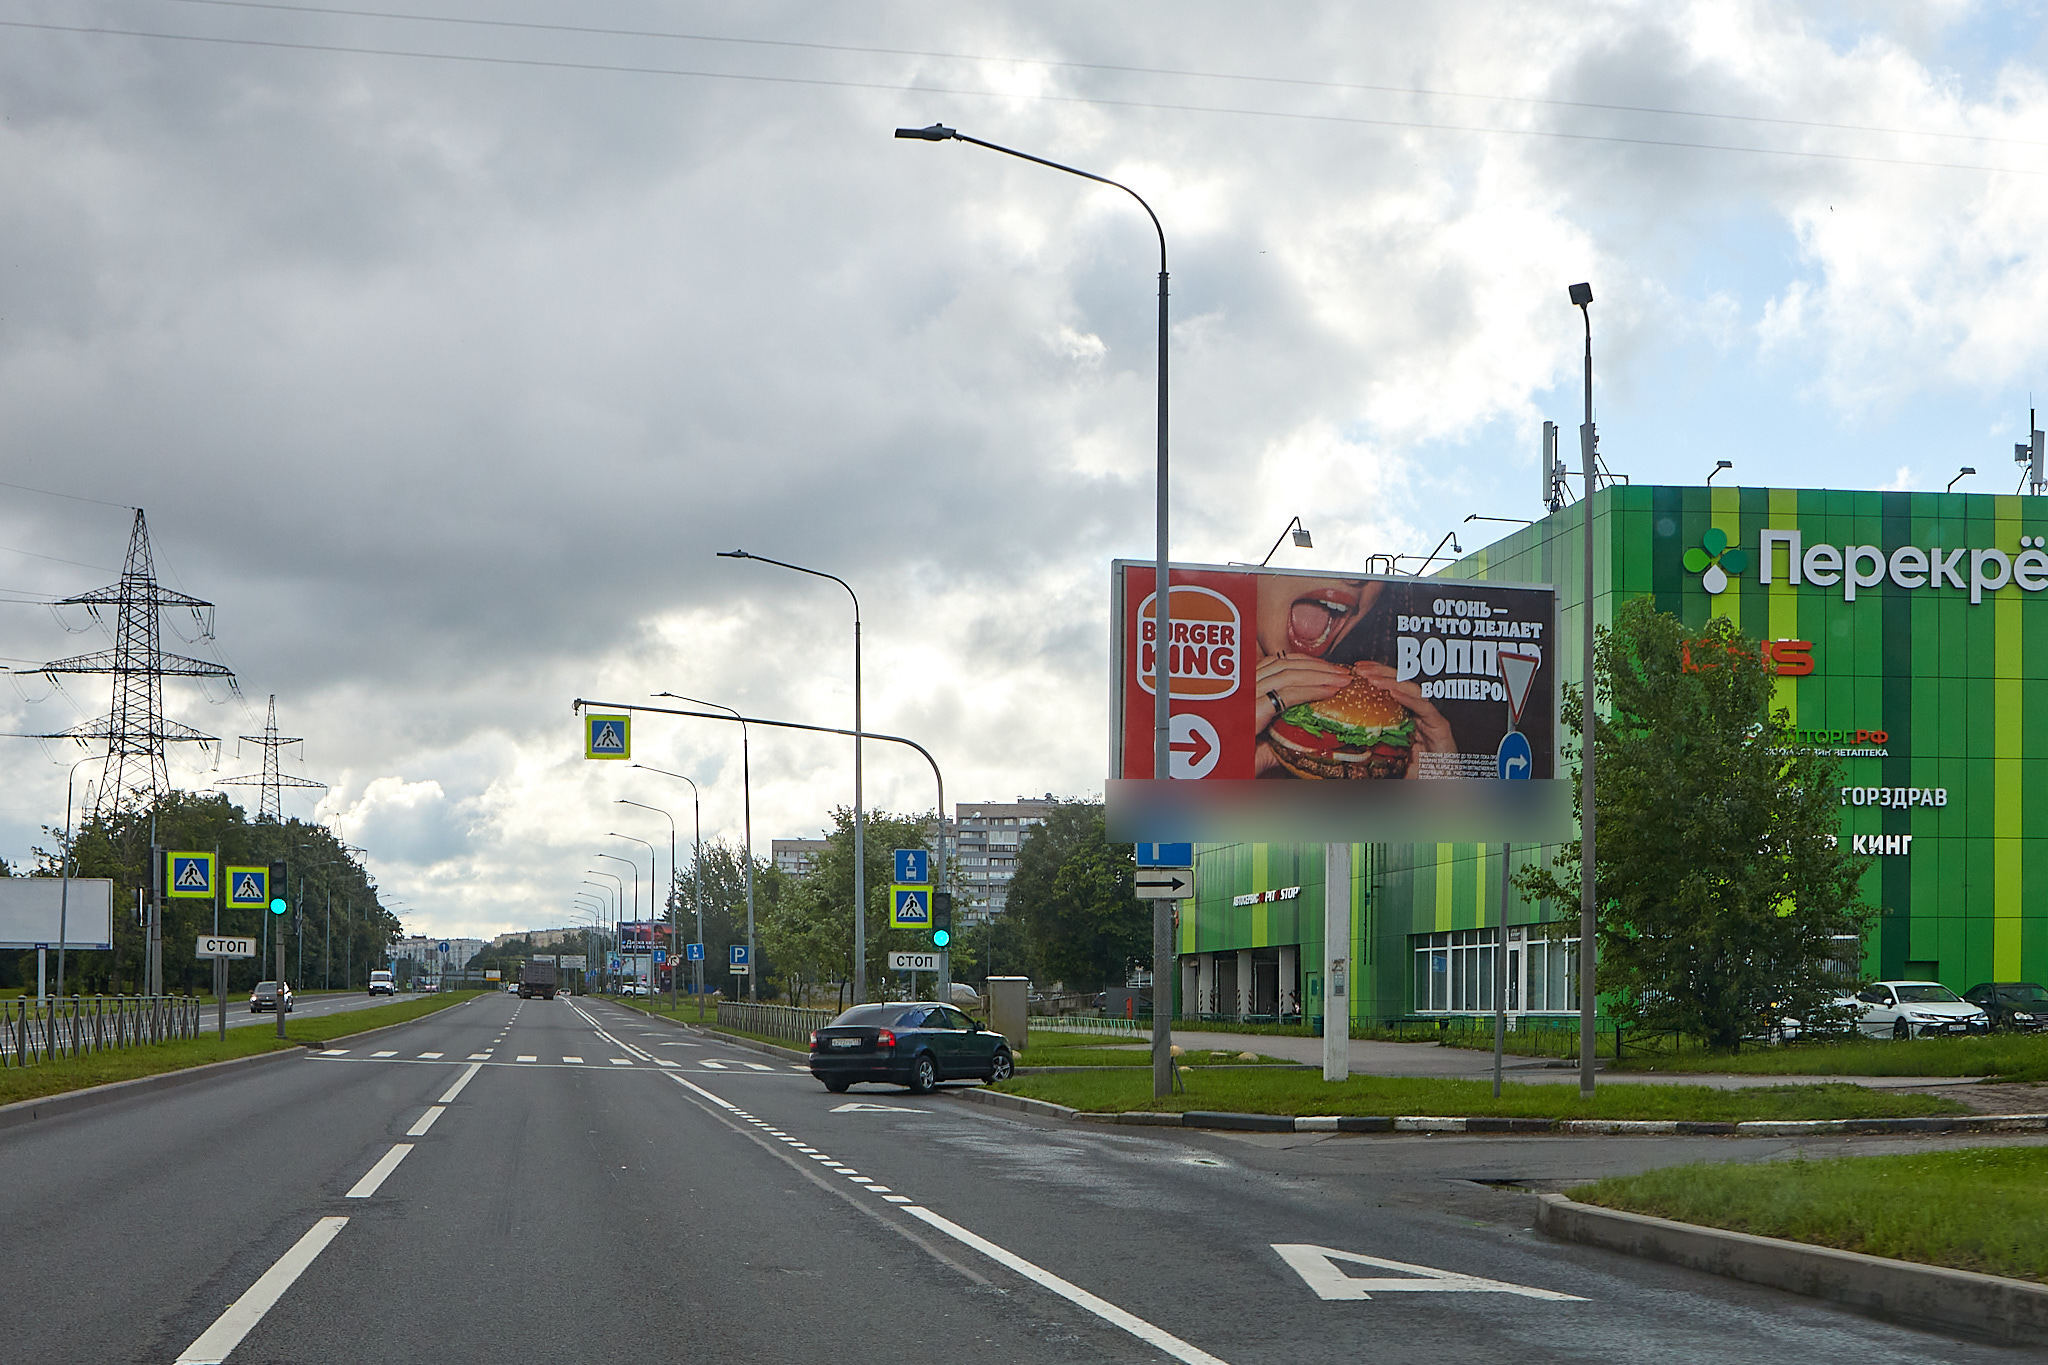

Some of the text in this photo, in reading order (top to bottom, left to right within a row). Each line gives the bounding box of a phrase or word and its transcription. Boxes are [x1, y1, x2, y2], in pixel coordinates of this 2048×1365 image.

[1432, 598, 1491, 618] ОГОНЬ
[1142, 620, 1235, 646] BRGER
[1397, 615, 1543, 638] ВОТ ЧТО ДЕЛАЕТ
[1421, 679, 1507, 701] ВОППЕРО
[1841, 787, 1947, 809] ГОРЗДРАВ
[1853, 834, 1912, 855] КИНГ
[1265, 891, 1276, 902] PIT
[1280, 887, 1300, 900] STOP
[206, 939, 247, 953] СТОП
[734, 947, 746, 963] P
[896, 955, 933, 968] СТОП
